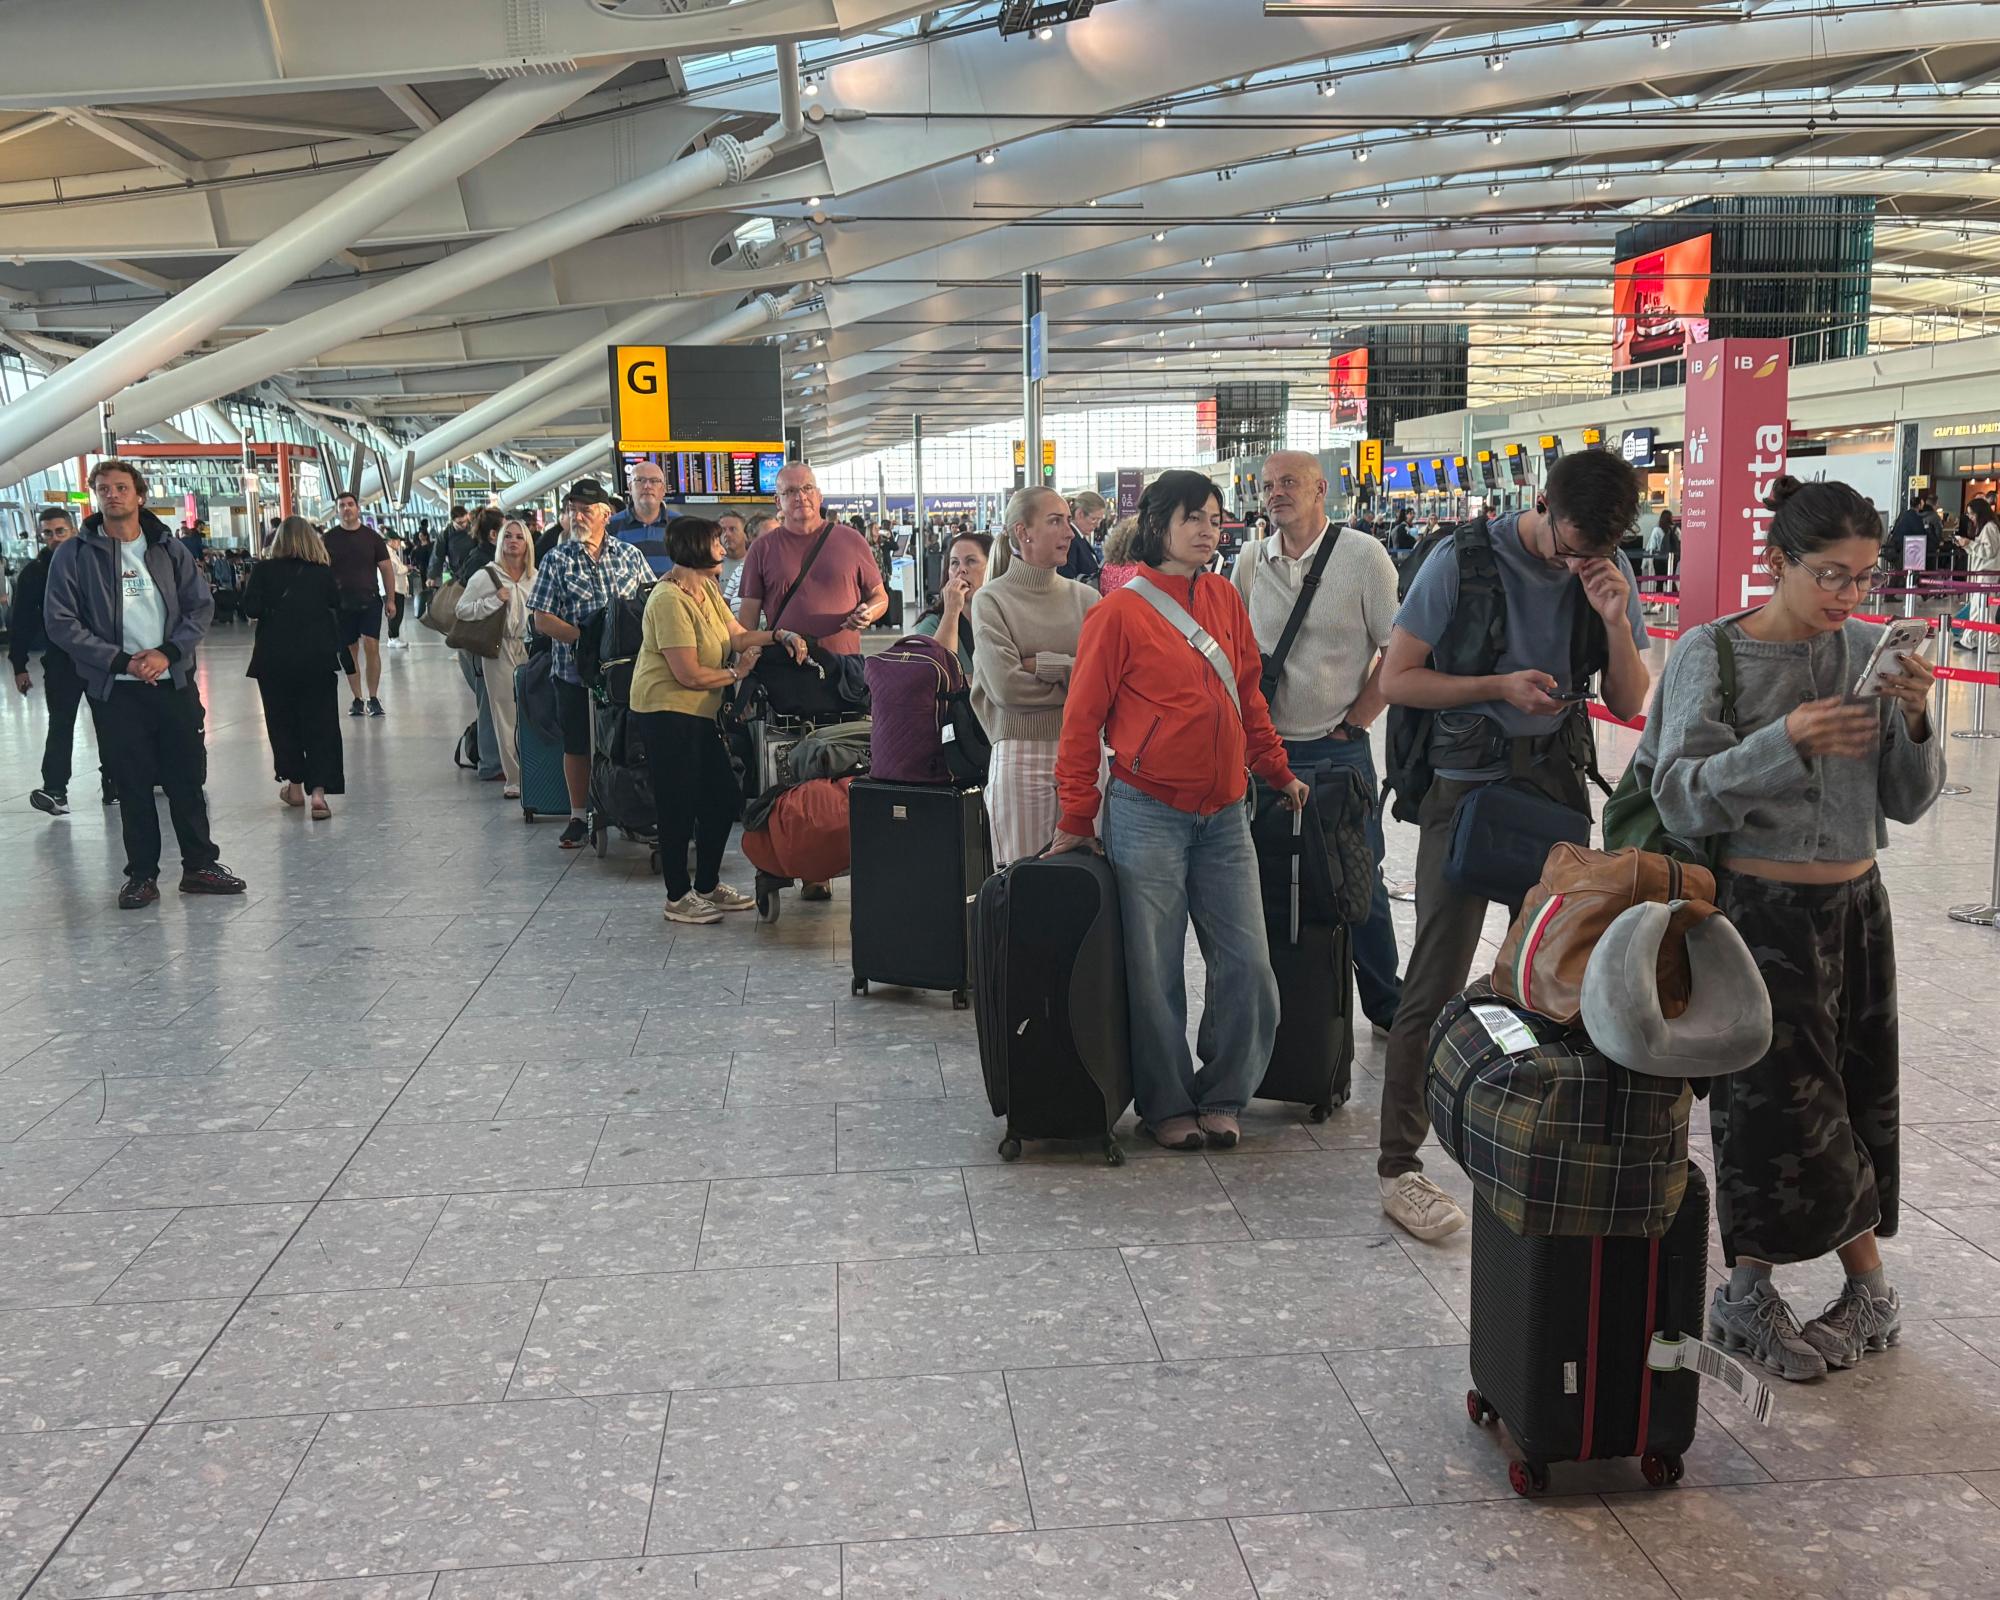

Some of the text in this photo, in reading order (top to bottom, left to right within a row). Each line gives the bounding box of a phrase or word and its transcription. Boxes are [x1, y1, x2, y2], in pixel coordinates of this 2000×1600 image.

[1691, 360, 1703, 374] IB
[1734, 356, 1753, 369] IB
[627, 361, 658, 395] G
[1934, 426, 1954, 437] CRAFT
[1366, 446, 1375, 461] E
[1688, 477, 1715, 486] Facturación
[1688, 489, 1704, 498] Turista
[934, 500, 941, 508] A
[1687, 519, 1707, 529] Economy
